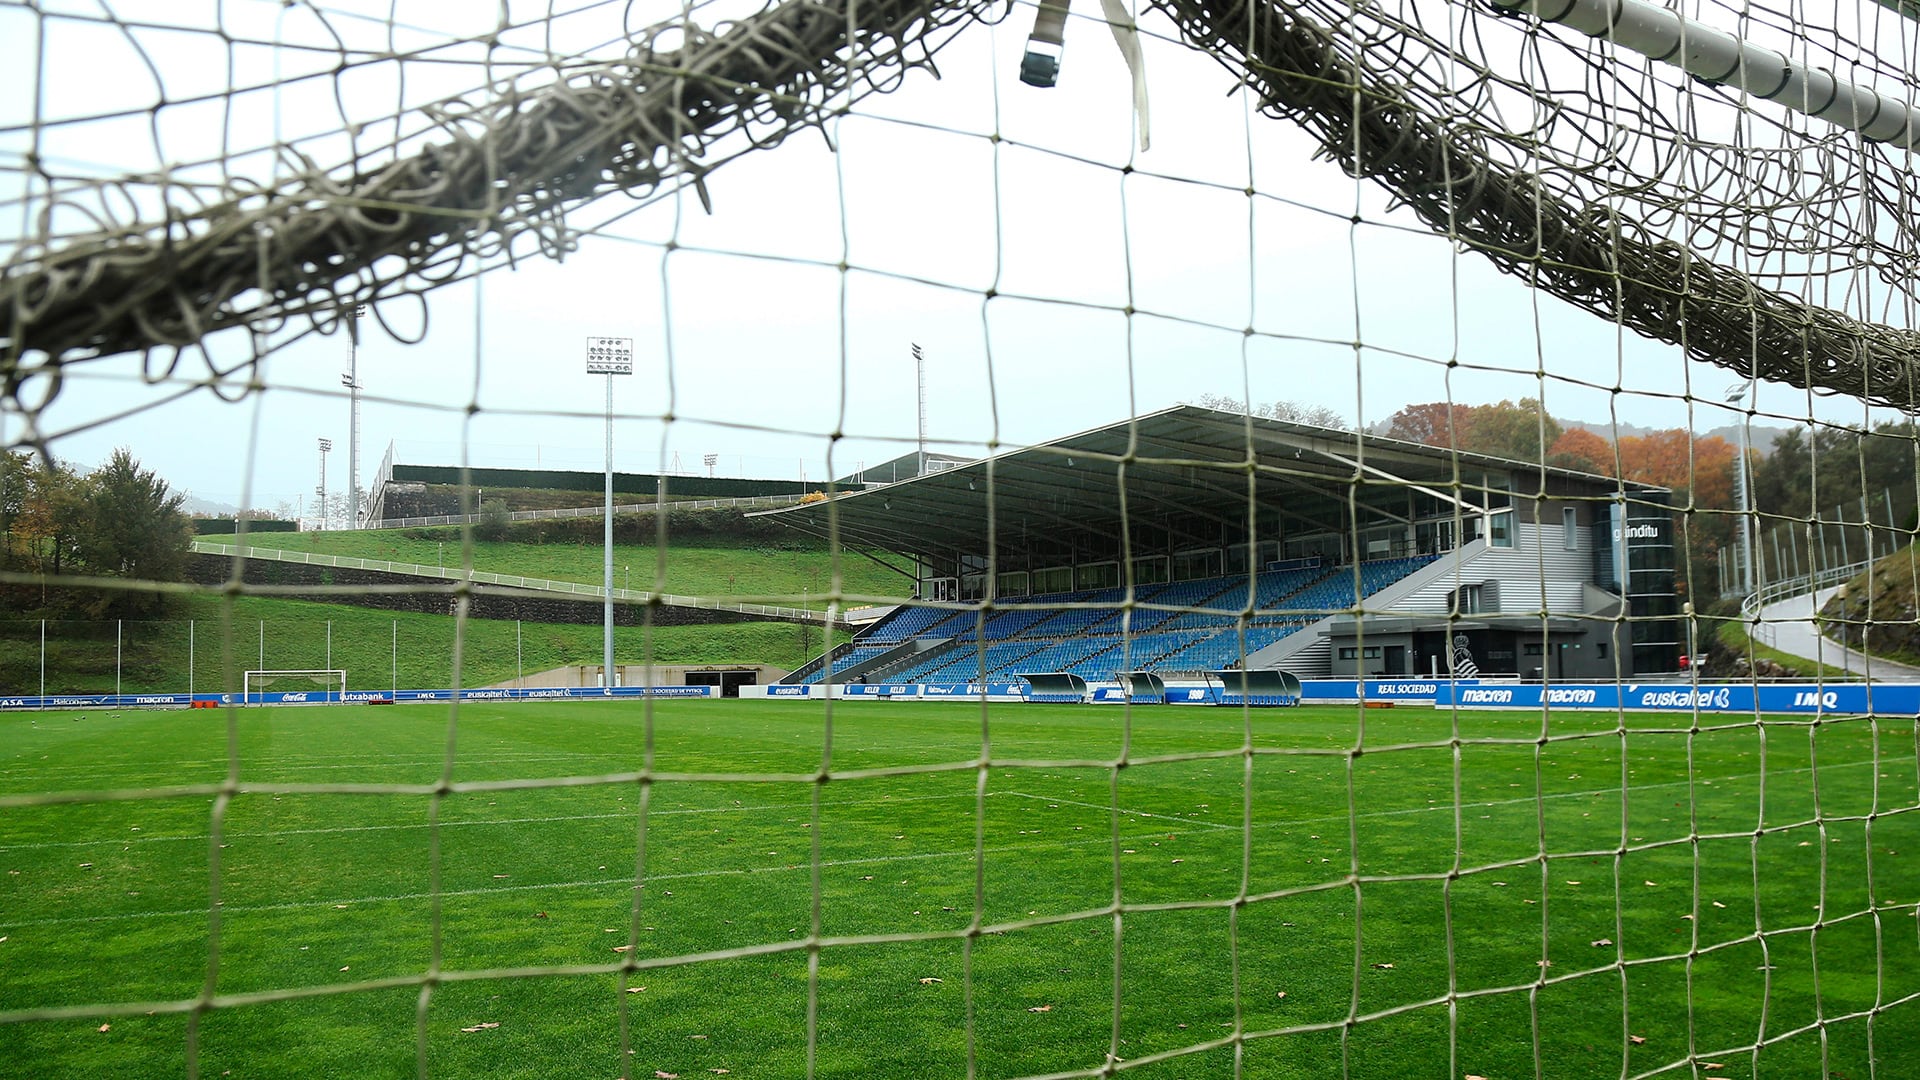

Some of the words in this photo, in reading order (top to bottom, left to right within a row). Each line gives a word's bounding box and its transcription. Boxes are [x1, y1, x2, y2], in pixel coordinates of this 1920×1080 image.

[1614, 524, 1658, 541] ginditu
[467, 690, 503, 698] euskaltel
[1378, 684, 1396, 694] REAL
[1397, 684, 1437, 694] SOCIEDAD
[1462, 690, 1512, 702] macron
[1539, 690, 1596, 702] macron
[1642, 690, 1715, 707] euskaltel
[1794, 692, 1838, 708] IMQ
